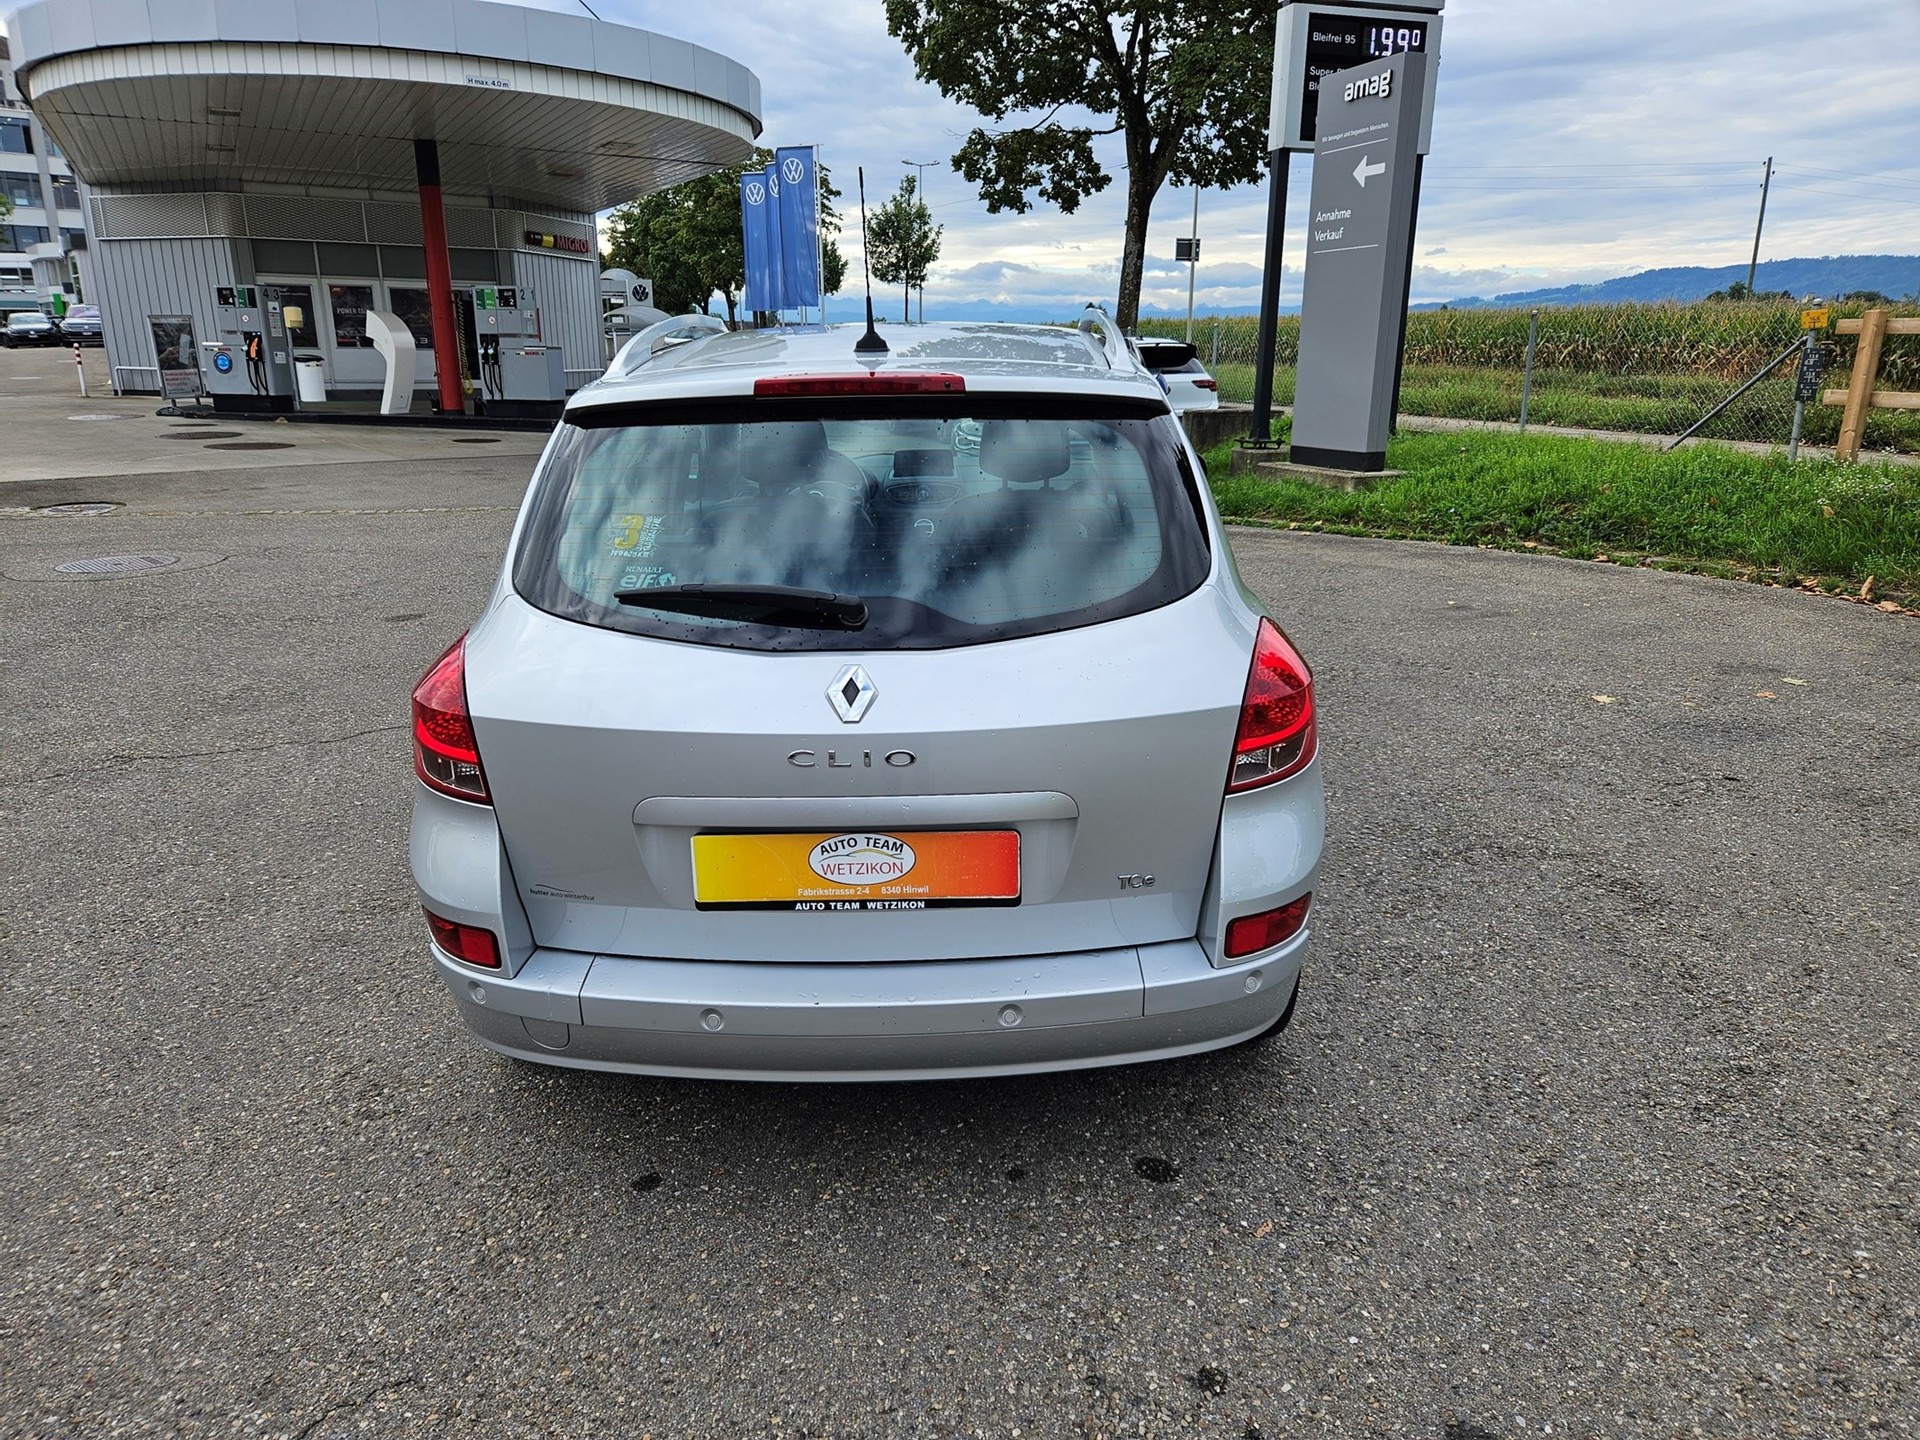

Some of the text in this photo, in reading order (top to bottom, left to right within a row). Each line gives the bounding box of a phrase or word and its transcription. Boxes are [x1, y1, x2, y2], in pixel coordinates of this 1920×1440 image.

[1312, 31, 1343, 44] Bleifrei
[1344, 34, 1356, 44] 95
[1309, 65, 1335, 77] Super
[490, 80, 502, 88] 4.0
[1343, 68, 1393, 102] amag
[1315, 208, 1352, 223] Annahme
[1314, 226, 1344, 242] Verkauf
[262, 288, 270, 299] 4
[273, 288, 280, 300] 3
[519, 288, 526, 301] 2
[614, 513, 644, 550] 3
[625, 565, 664, 573] RENAULT
[619, 573, 657, 589] elf
[786, 748, 919, 769] CLIO
[819, 835, 904, 857] AUTO TEAM
[819, 860, 904, 877] WETZIKON
[1117, 872, 1156, 890] TCe
[550, 890, 564, 898] auto
[797, 884, 930, 897] Fabrikstrasse 2-4 8340 Hinwil
[795, 900, 926, 911] AUTO TEAM WETZIKON
